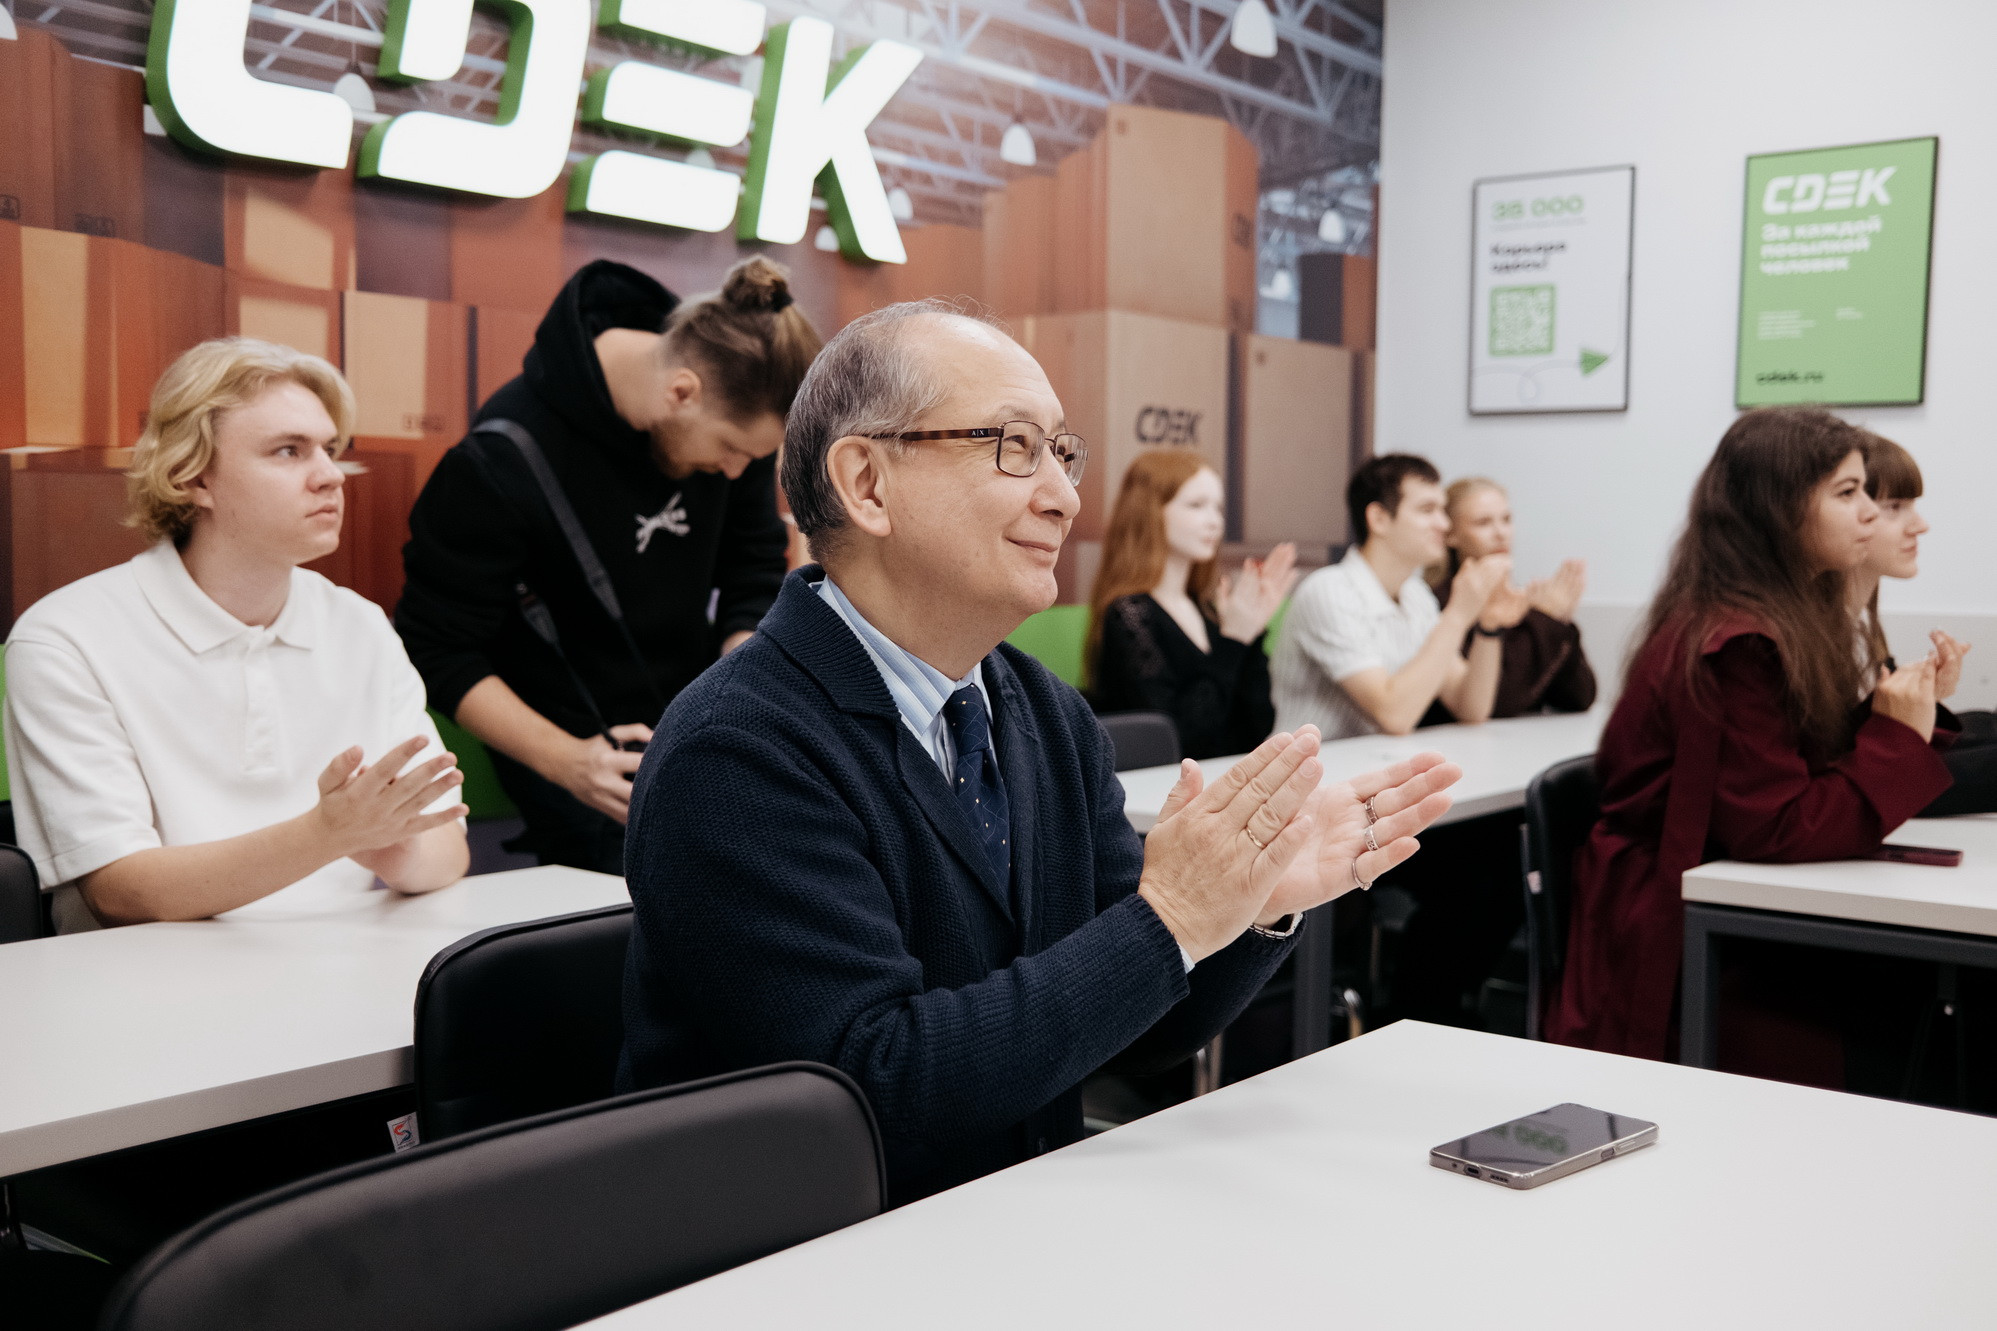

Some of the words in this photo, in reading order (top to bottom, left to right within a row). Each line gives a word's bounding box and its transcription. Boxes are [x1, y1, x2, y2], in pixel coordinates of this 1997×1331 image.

[147, 0, 924, 265] CDEK
[1531, 194, 1584, 217] 000
[1763, 166, 1897, 214] CDEK
[1136, 406, 1203, 445] CDEK
